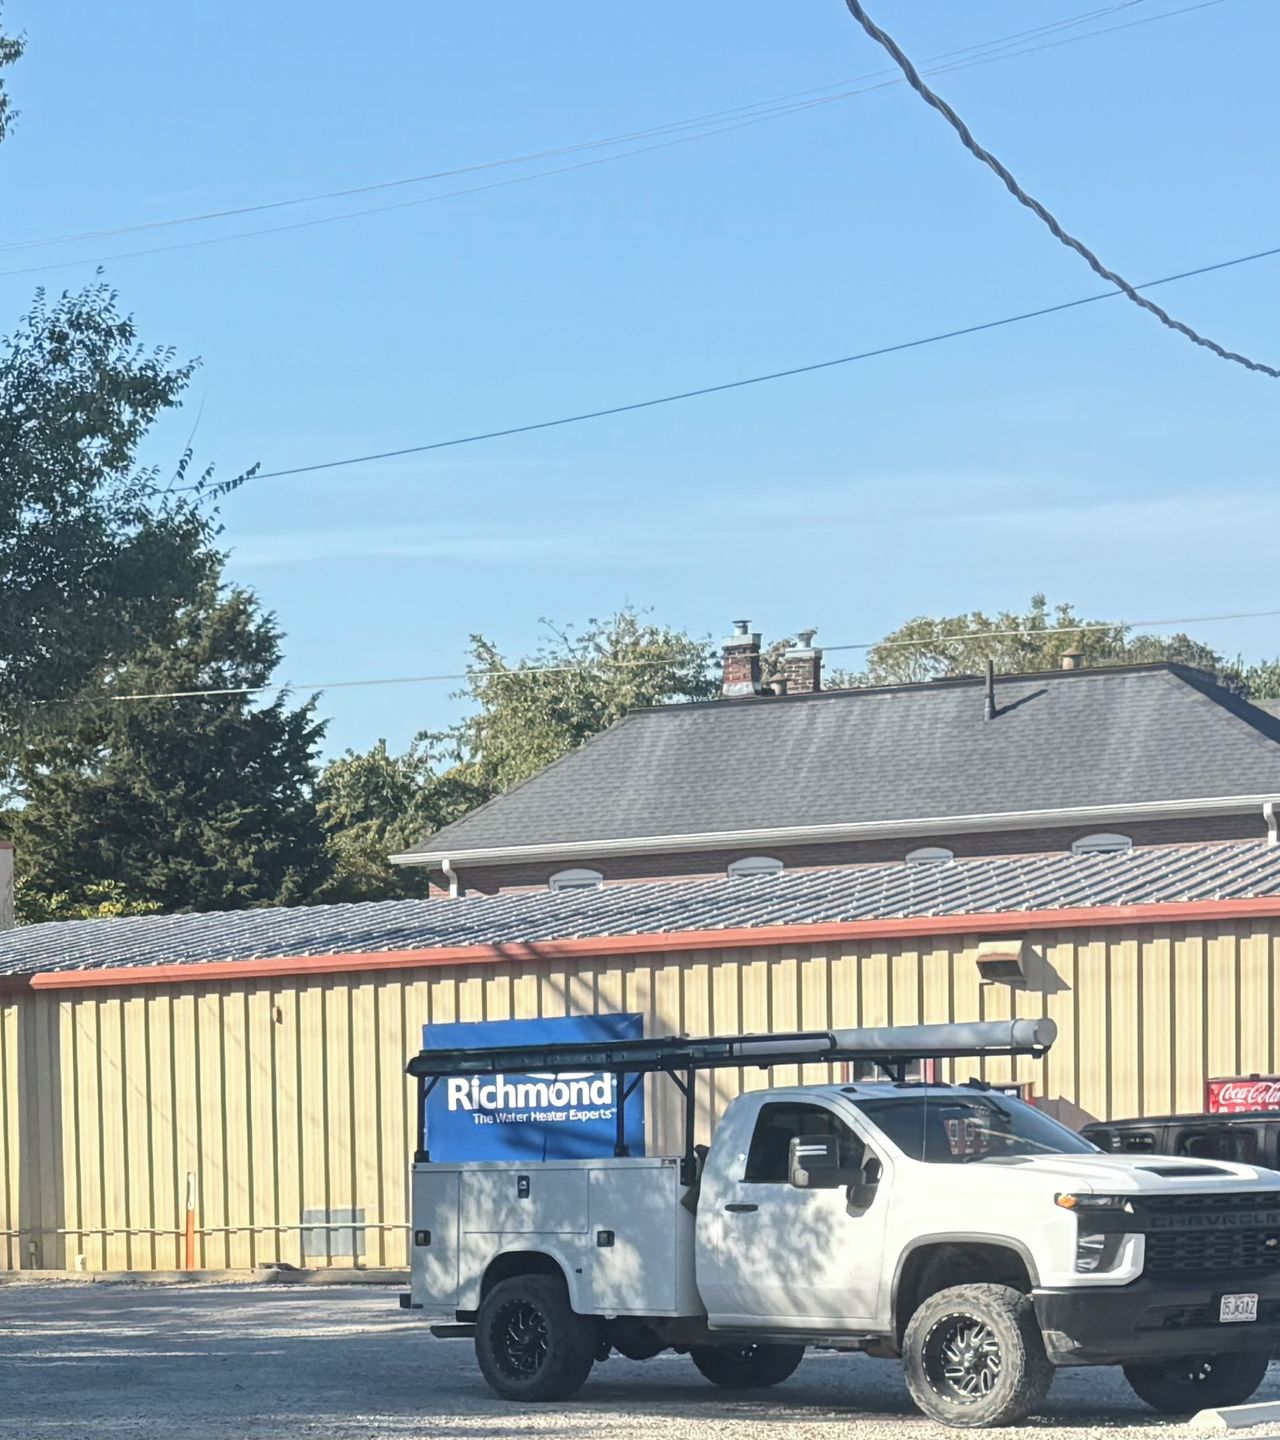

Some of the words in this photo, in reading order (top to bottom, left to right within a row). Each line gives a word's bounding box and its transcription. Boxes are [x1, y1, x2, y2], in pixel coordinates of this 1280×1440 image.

[448, 1072, 612, 1111] Richmond
[473, 1113, 493, 1125] The
[496, 1113, 527, 1124] Water
[531, 1110, 567, 1122] Heater
